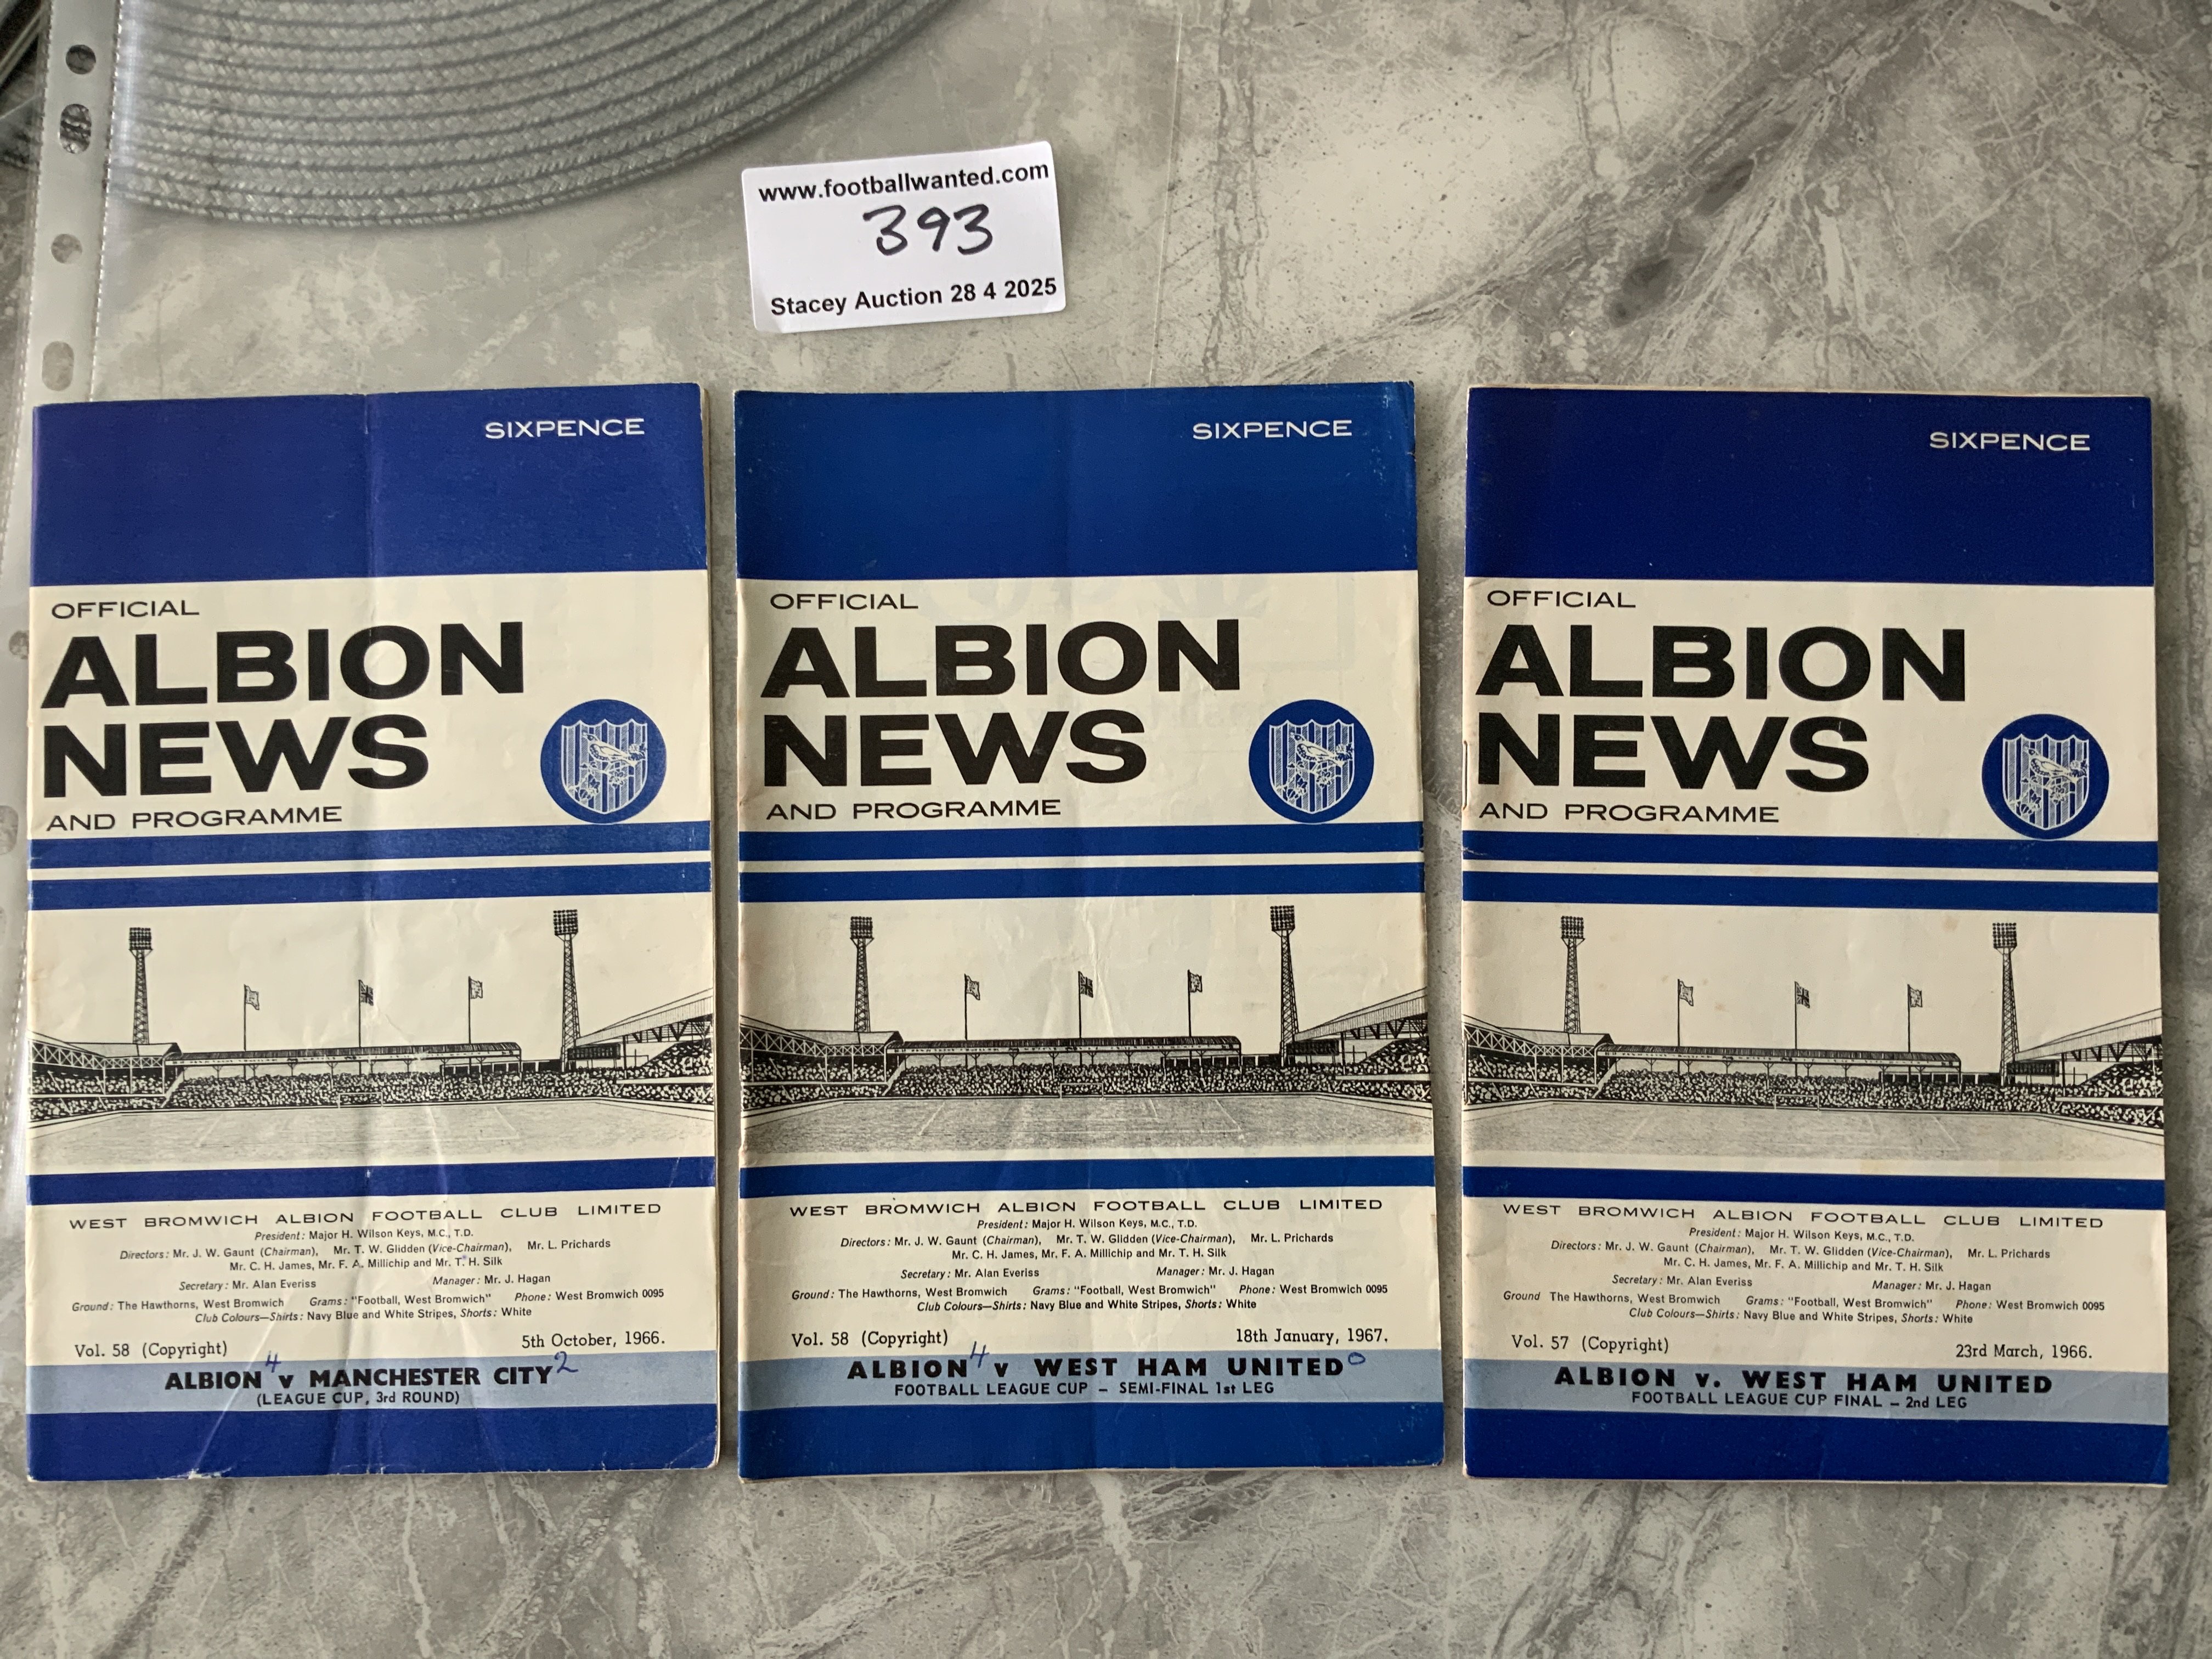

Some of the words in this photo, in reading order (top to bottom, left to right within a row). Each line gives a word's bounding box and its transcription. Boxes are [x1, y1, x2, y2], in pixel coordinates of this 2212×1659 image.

[759, 165, 1048, 201] www.footballwanted.com
[863, 204, 992, 255] 393
[772, 298, 846, 315] Stacey
[855, 288, 941, 309] Auction
[951, 284, 975, 302] 28
[984, 283, 996, 299] 4
[1005, 278, 1056, 298] 2025
[486, 417, 645, 439] SIXPENCE
[1193, 420, 1352, 439] SIXPENCE
[1930, 432, 2090, 451] SIXPENCE
[52, 600, 200, 619] OFFICIAL
[770, 594, 918, 610] OFFICIAL
[1487, 590, 1636, 608] OFFICIAL
[41, 622, 523, 708] ALBION
[760, 619, 1239, 698] ALBION
[1476, 625, 1965, 701] ALBION
[44, 715, 428, 797] NEWS
[764, 710, 1146, 786] NEWS
[1479, 713, 1869, 792] NEWS
[47, 814, 115, 831] AND
[133, 806, 341, 828] PROGRAMME
[766, 804, 836, 820] AND
[854, 799, 1060, 819] PROGRAMME
[1479, 803, 1548, 819] AND
[1565, 804, 1779, 822] PROGRAMME
[69, 1218, 127, 1229] WEST
[145, 1215, 257, 1227] BROMWICH
[275, 1213, 353, 1224] ALBION
[373, 1210, 482, 1221] FOOTBALL
[501, 1207, 557, 1218] CLUB
[578, 1204, 661, 1215] LIMITED
[790, 1205, 848, 1217] WEST
[866, 1203, 979, 1215] BROMWICH
[998, 1202, 1075, 1212] ALBION
[1094, 1200, 1205, 1211] FOOTBALL
[1223, 1200, 1279, 1210] CLUB
[1300, 1200, 1382, 1210] LIMITED
[1503, 1204, 1560, 1215] WEST
[1579, 1206, 1694, 1218] BROMWICH
[1713, 1210, 1792, 1221] ALBION
[1812, 1212, 1926, 1224] FOOTBALL
[1944, 1216, 1999, 1226] CLUB
[2020, 1217, 2103, 1228] LIMITED
[255, 1232, 304, 1240] President:
[309, 1231, 338, 1241] Major
[342, 1230, 353, 1238] H.
[357, 1229, 392, 1238] Wilson
[397, 1229, 423, 1238] Keys,
[428, 1229, 450, 1238] M.C.,
[120, 1250, 169, 1259] Directors:
[173, 1249, 189, 1257] Mr.
[193, 1249, 201, 1257] J.
[206, 1249, 219, 1257] W.
[224, 1248, 254, 1257] Gaunt
[261, 1246, 318, 1257] (Chairman),
[334, 1246, 350, 1254] Mr.
[354, 1245, 364, 1254] T.
[369, 1245, 382, 1253] W.
[387, 1244, 425, 1253] Glidden
[428, 1242, 511, 1254] (Vice-Chairman),
[528, 1241, 544, 1250] Mr.
[549, 1240, 557, 1249] L.
[562, 1239, 611, 1249] Prichards
[901, 1269, 950, 1280] Secretary:
[955, 1269, 970, 1278] Mr.
[975, 1268, 998, 1277] Alan
[1003, 1268, 1039, 1277] Everiss
[1156, 1267, 1204, 1278] Manager:
[1209, 1266, 1224, 1276] Mr.
[1229, 1266, 1238, 1276] J.
[1242, 1266, 1274, 1277] Hagan
[1504, 1290, 1541, 1300] Ground
[1549, 1291, 1570, 1301] The
[1574, 1292, 1632, 1304] Hawthorns,
[1638, 1294, 1664, 1303] West
[1669, 1295, 1720, 1304] Bromwich
[1746, 1295, 1784, 1306] Grams:
[1843, 1297, 1870, 1308] West
[1956, 1300, 1991, 1309] Phone:
[1996, 1300, 2023, 1310] West
[2027, 1300, 2078, 1310] Bromwich
[2083, 1301, 2104, 1311] 0095
[1629, 1308, 1652, 1317] Club
[1744, 1310, 1768, 1322] Navy
[1773, 1311, 1795, 1321] Blue
[1799, 1312, 1818, 1321] and
[1822, 1312, 1853, 1322] White
[1857, 1312, 1897, 1324] Stripes,
[1901, 1313, 1938, 1323] Shorts:
[1943, 1313, 1973, 1323] White
[522, 1334, 544, 1348] 5th
[551, 1333, 616, 1347] October,
[625, 1331, 664, 1345] 1966.
[792, 1332, 823, 1347] Vol.
[831, 1331, 848, 1346] 58
[862, 1329, 947, 1348] (Copyright)
[1237, 1329, 1267, 1342] 18th
[1274, 1328, 1339, 1345] January,
[1348, 1328, 1387, 1342] 1967.
[1511, 1334, 1543, 1348] Vol.
[1551, 1336, 1568, 1350] 57
[1582, 1335, 1668, 1354] (Copyright)
[75, 1344, 105, 1357] Vol.
[112, 1344, 129, 1357] 58
[143, 1340, 227, 1358] (Copyright)
[970, 1341, 990, 1368] 4
[1956, 1344, 1987, 1358] 23rd
[1994, 1344, 2042, 1359] March,
[2052, 1345, 2092, 1358] 1966.
[265, 1350, 281, 1373] 4
[554, 1351, 579, 1373] 2
[847, 1359, 967, 1379] ALBION
[994, 1363, 1008, 1377] v
[1034, 1357, 1118, 1376] WEST
[1138, 1358, 1206, 1376] HAM
[1228, 1357, 1343, 1375] UNITED
[165, 1371, 261, 1390] ALBION
[278, 1375, 294, 1389] v
[310, 1367, 481, 1387] MANCHESTER
[494, 1365, 553, 1384] CITY
[1555, 1366, 1674, 1386] ALBION
[1695, 1373, 1720, 1387] v.
[1742, 1370, 1826, 1390] WEST
[1847, 1373, 1916, 1392] HAM
[1938, 1374, 2052, 1393] UNITED
[257, 1393, 325, 1407] (LEAGUE
[332, 1392, 369, 1405] CUP,
[377, 1391, 395, 1402] 3rd
[403, 1391, 459, 1404] ROUND)
[895, 1384, 979, 1396] FOOTBALL
[987, 1383, 1049, 1395] LEAGUE
[1057, 1382, 1087, 1394] CUP
[1120, 1382, 1208, 1394] SEMI-FINAL
[1216, 1382, 1235, 1394] 1st
[1243, 1382, 1274, 1393] LEG
[1633, 1391, 1717, 1404] FOOTBALL
[1725, 1392, 1787, 1404] LEAGUE
[1795, 1393, 1827, 1406] CUP
[1835, 1395, 1882, 1407] FINAL
[1906, 1396, 1929, 1408] 2nd
[1937, 1397, 1967, 1408] LEG
